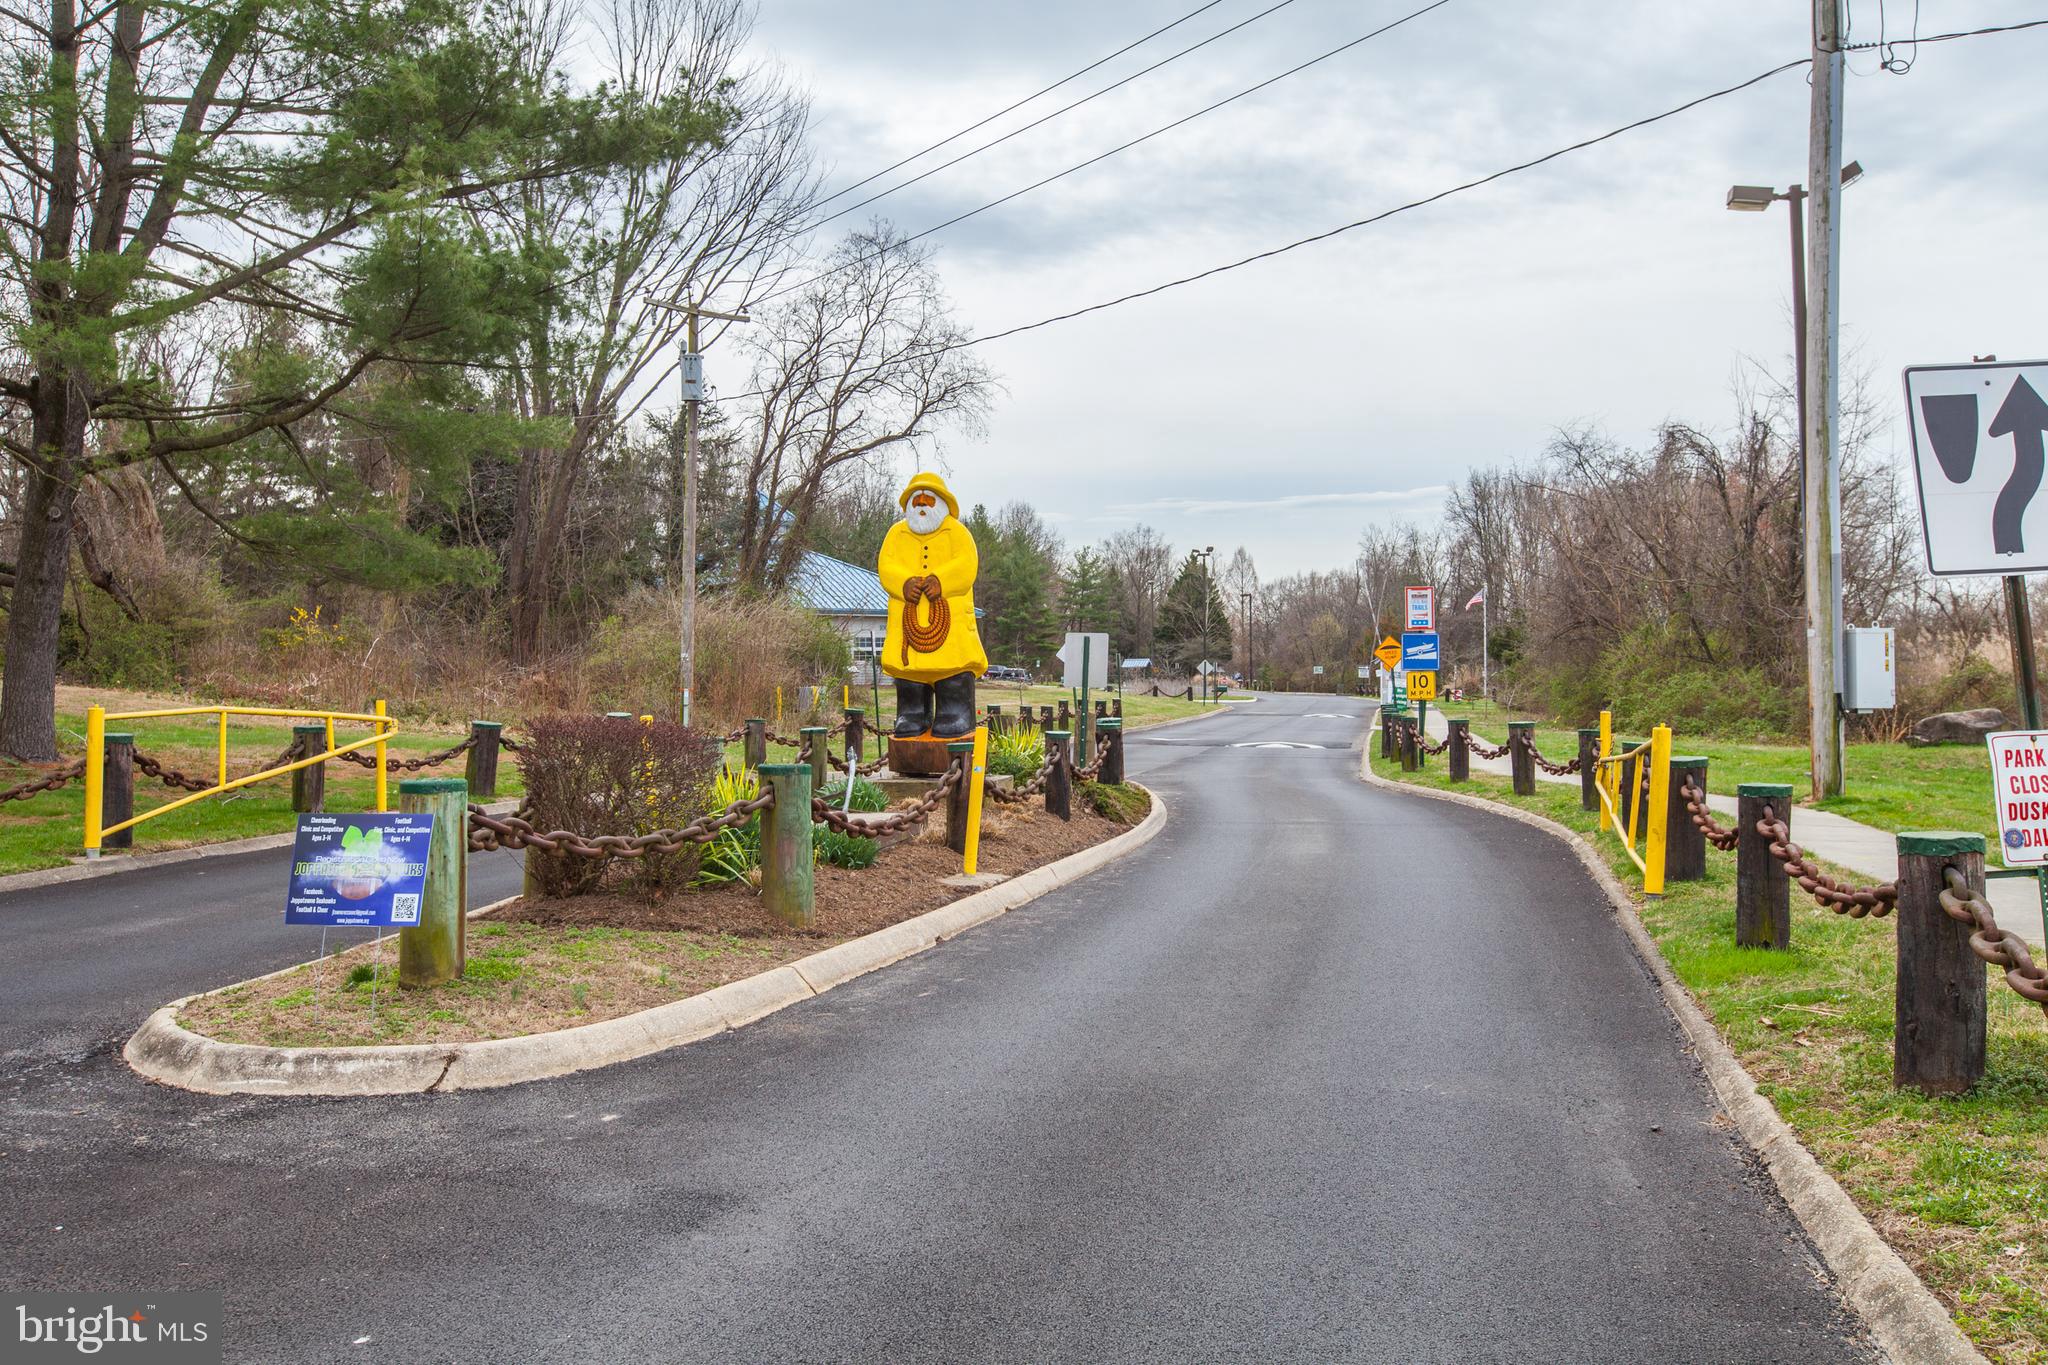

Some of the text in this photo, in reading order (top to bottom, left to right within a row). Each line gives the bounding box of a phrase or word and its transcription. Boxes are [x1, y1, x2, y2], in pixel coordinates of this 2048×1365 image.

[1413, 674, 1429, 689] 10
[2004, 749, 2047, 768] PARK
[310, 816, 337, 825] Cheerleading
[394, 817, 413, 825] Football
[300, 825, 312, 833] Clinic
[312, 825, 321, 833] and
[397, 826, 405, 834] and
[405, 826, 430, 835] Competitive
[312, 834, 322, 842] Ages
[390, 835, 401, 843] Ages
[295, 905, 313, 913] Football
[316, 905, 329, 913] Cheer
